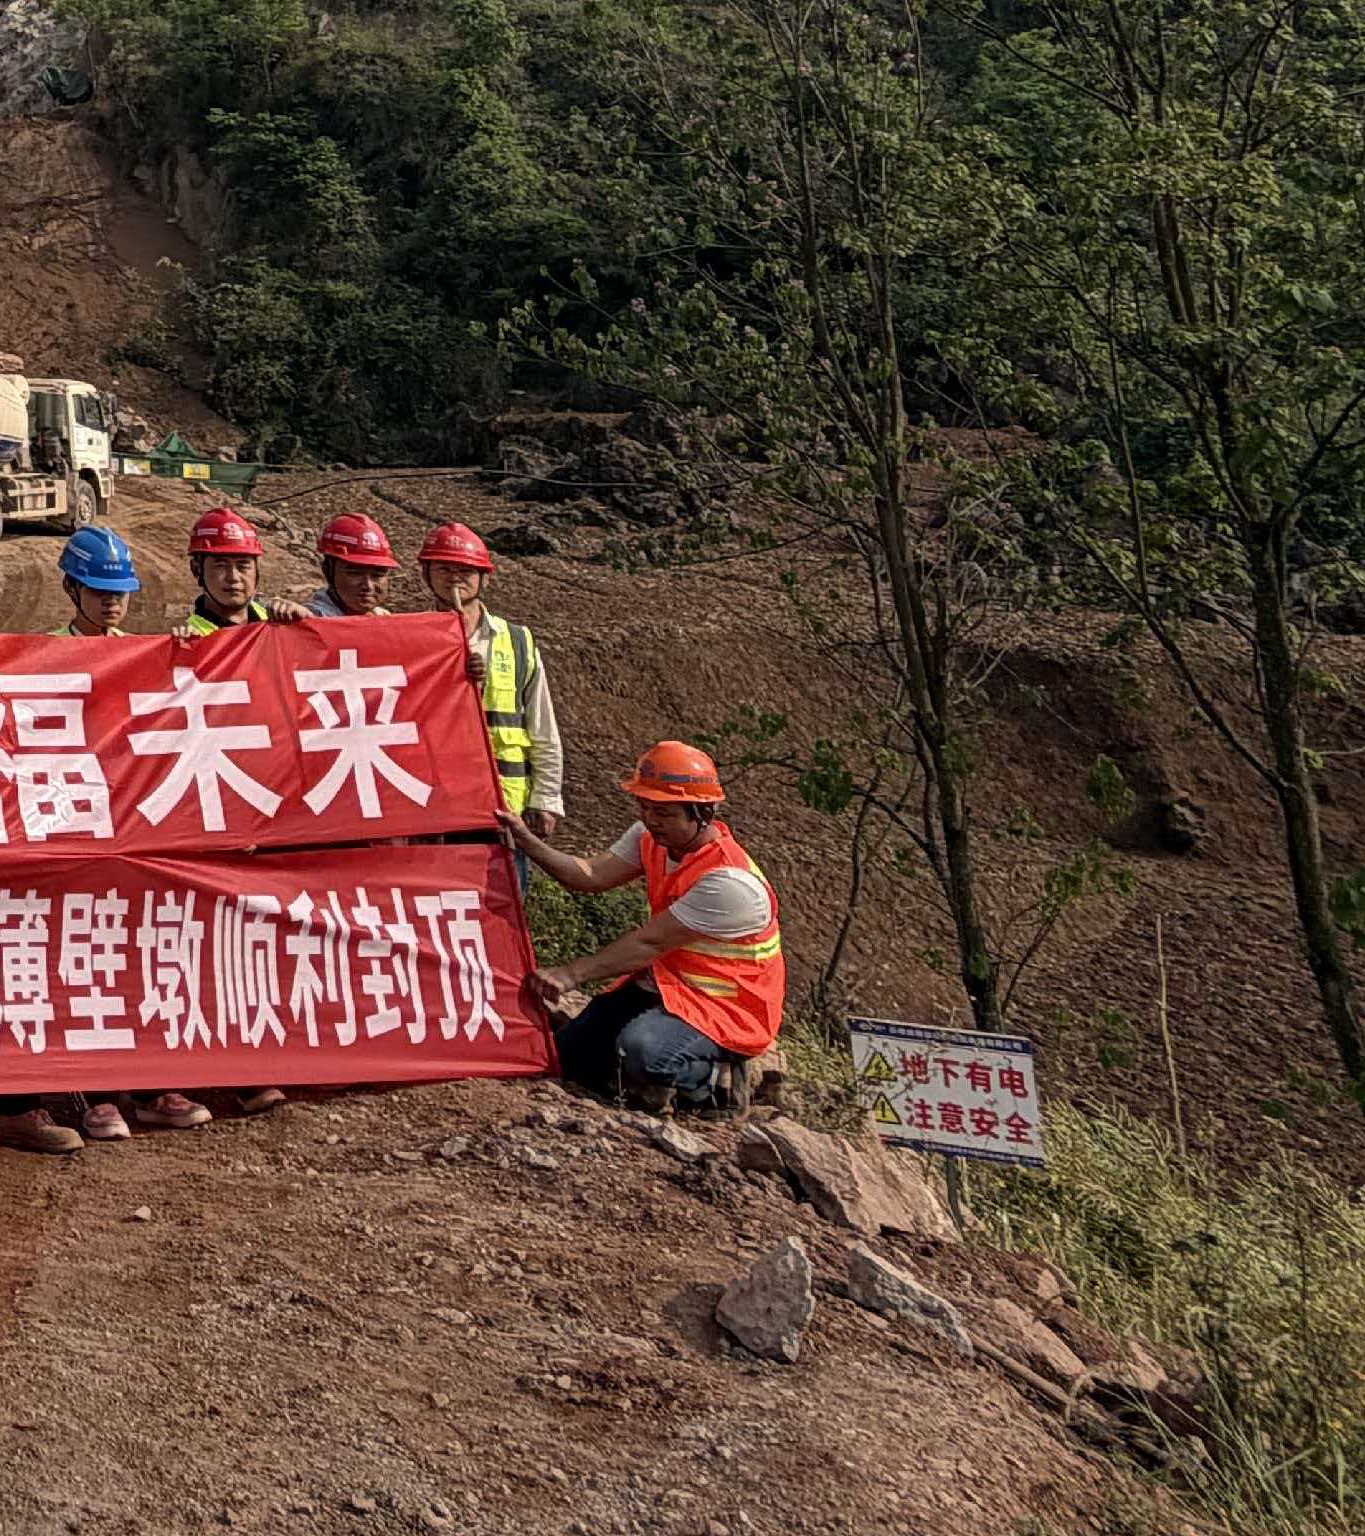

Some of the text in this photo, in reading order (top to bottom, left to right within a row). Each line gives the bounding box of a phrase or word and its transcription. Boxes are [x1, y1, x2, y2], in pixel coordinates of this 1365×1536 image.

[899, 1052, 1029, 1099] 地下有电
[904, 1098, 1034, 1145] 注意安全
